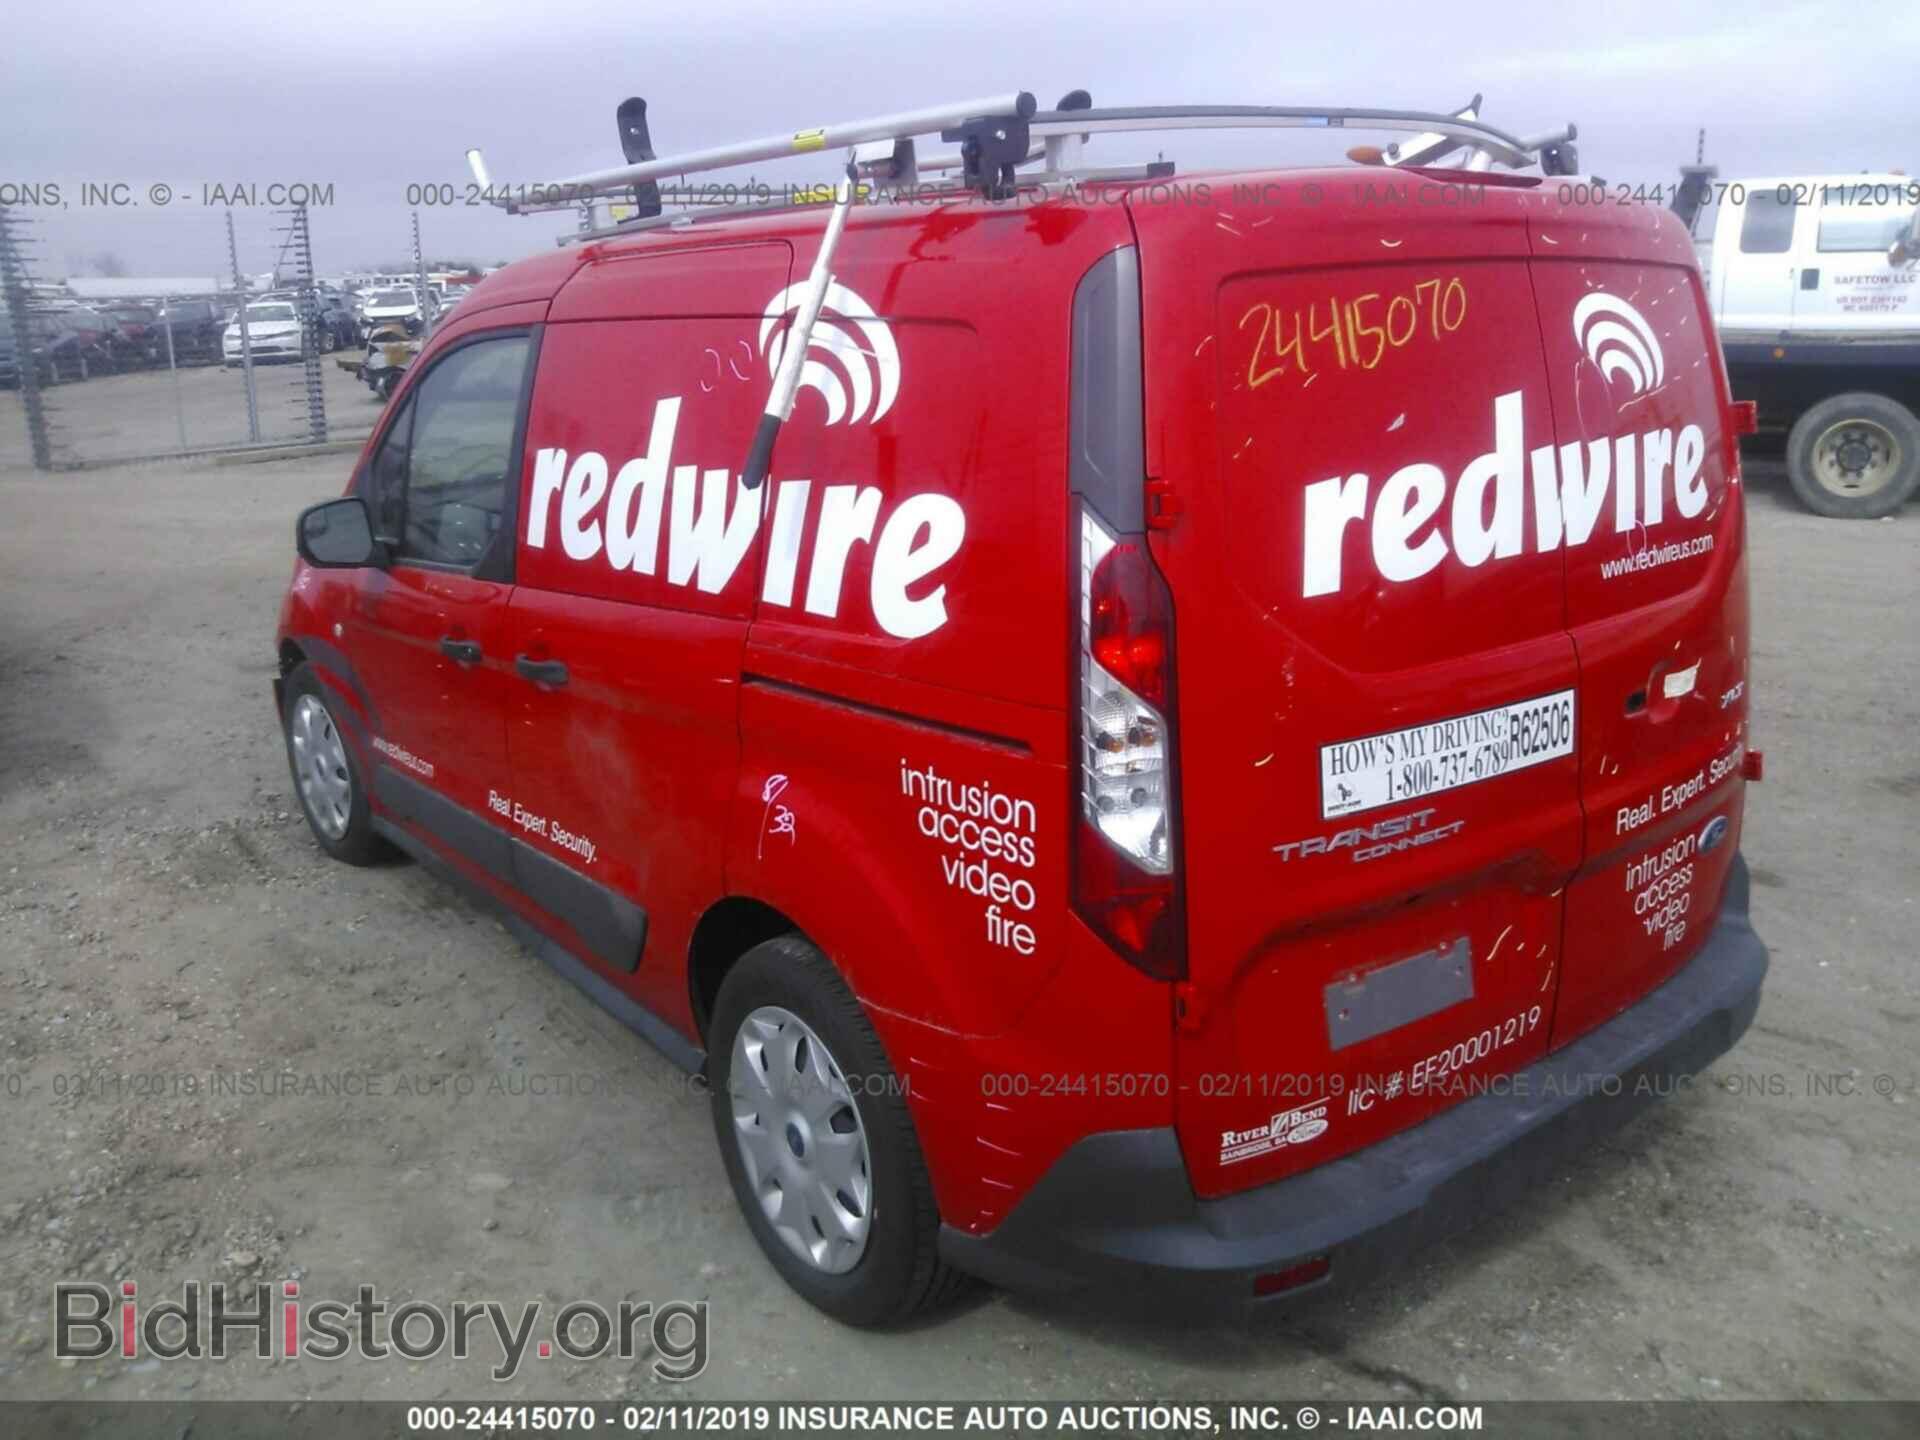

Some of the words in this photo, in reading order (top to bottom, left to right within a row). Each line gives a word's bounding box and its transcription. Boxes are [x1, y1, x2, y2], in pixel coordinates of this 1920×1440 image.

[1239, 277, 1466, 388] 24415070
[526, 395, 967, 640] redwire
[1302, 389, 1709, 600] redwire
[1601, 534, 1714, 579] www.redwireus.com
[1330, 735, 1395, 776] HOW'S
[1400, 727, 1427, 761] MY
[1432, 708, 1509, 754] DRIVING?
[1510, 700, 1570, 761] R62506
[901, 758, 1036, 832] intrusion
[1386, 740, 1509, 801] 1-800-737-6789
[918, 806, 1035, 868] access
[1273, 808, 1436, 862] TRANSIT
[1353, 820, 1465, 863] CONNECT
[1616, 795, 1656, 835] Real.
[942, 852, 1035, 911] video
[1625, 833, 1696, 892] intrusion
[1634, 863, 1694, 915] access
[985, 905, 1036, 955] fire
[1643, 892, 1690, 936] video
[1663, 920, 1687, 951] fire
[1411, 1005, 1541, 1089] EF20001219
[1221, 1126, 1269, 1148] RIVER
[1290, 1106, 1327, 1128] BEND
